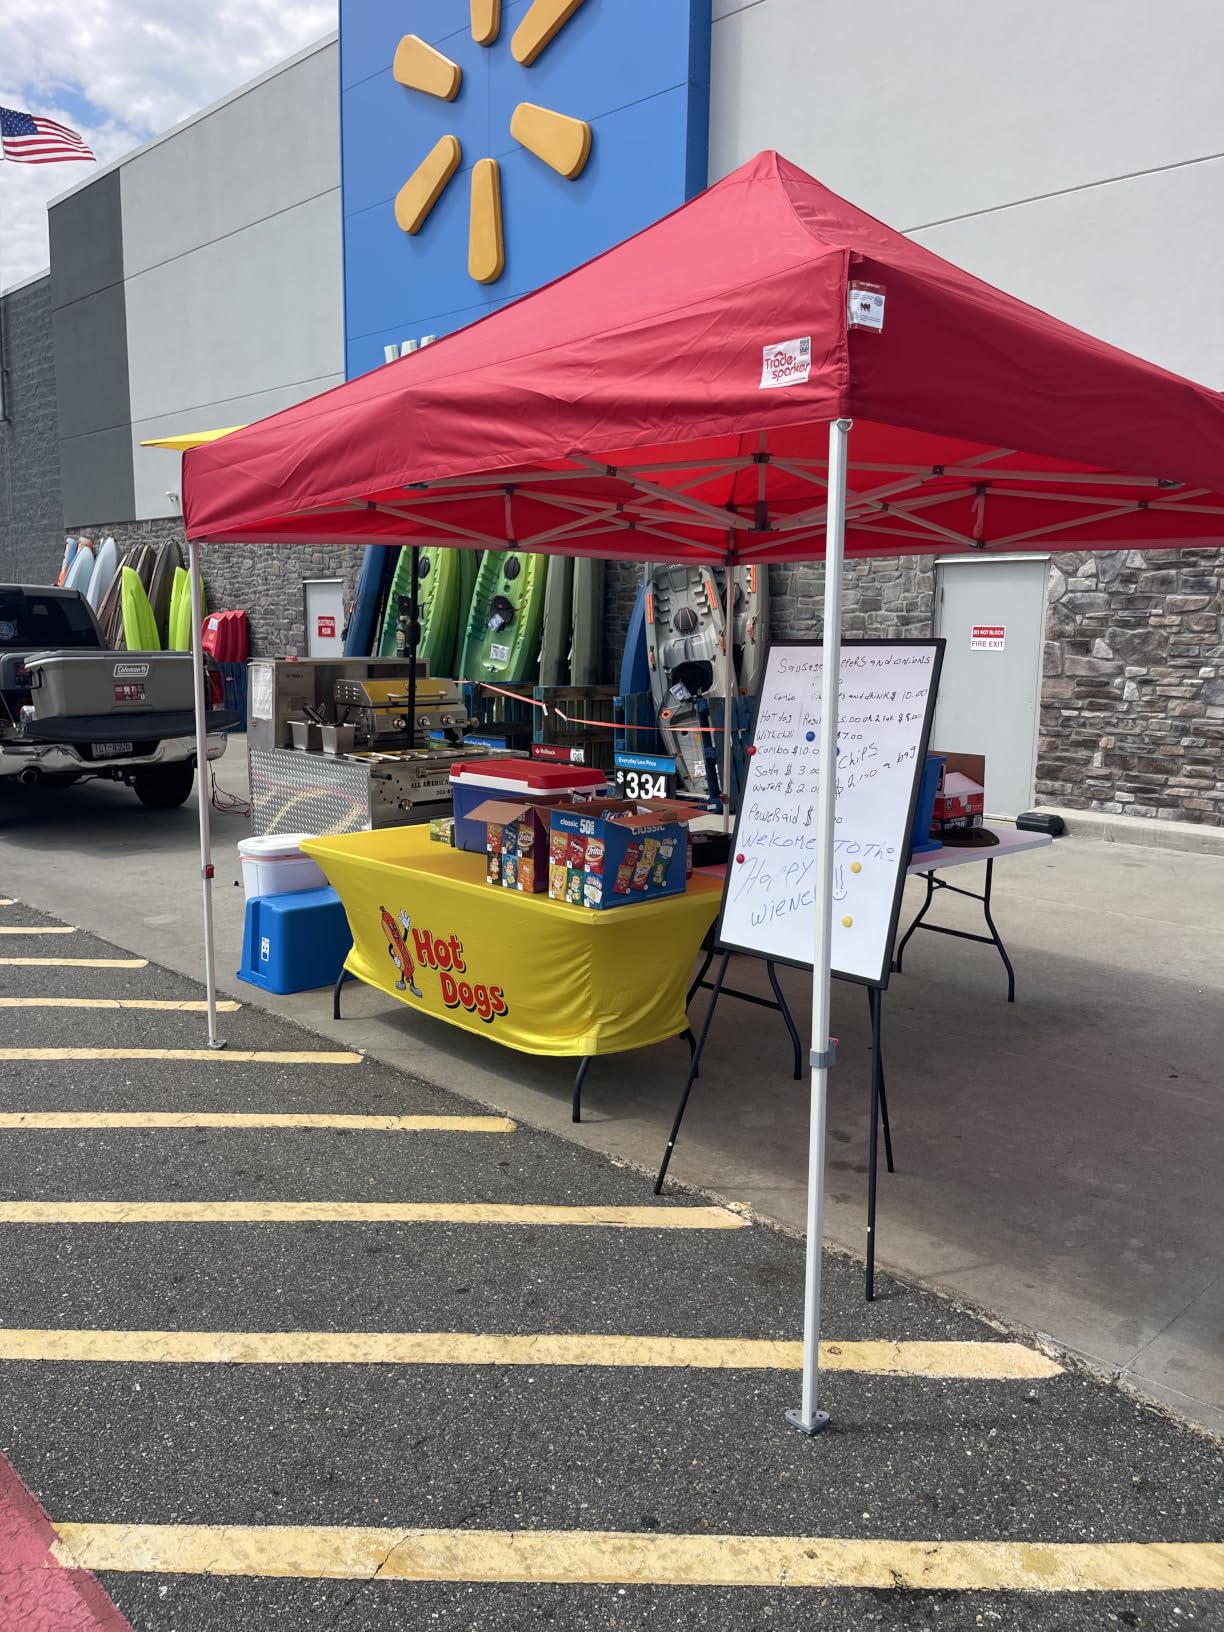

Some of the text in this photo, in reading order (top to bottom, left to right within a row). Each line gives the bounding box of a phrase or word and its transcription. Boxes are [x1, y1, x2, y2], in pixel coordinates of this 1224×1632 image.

[772, 363, 810, 381] sparker
[971, 640, 1004, 648] FIRE EXIT
[117, 665, 141, 673] Coleman
[618, 757, 638, 766] Everyday
[559, 817, 579, 828] classic
[579, 818, 591, 835] 50
[411, 926, 467, 974] Hot
[439, 970, 509, 1024] Dogs
